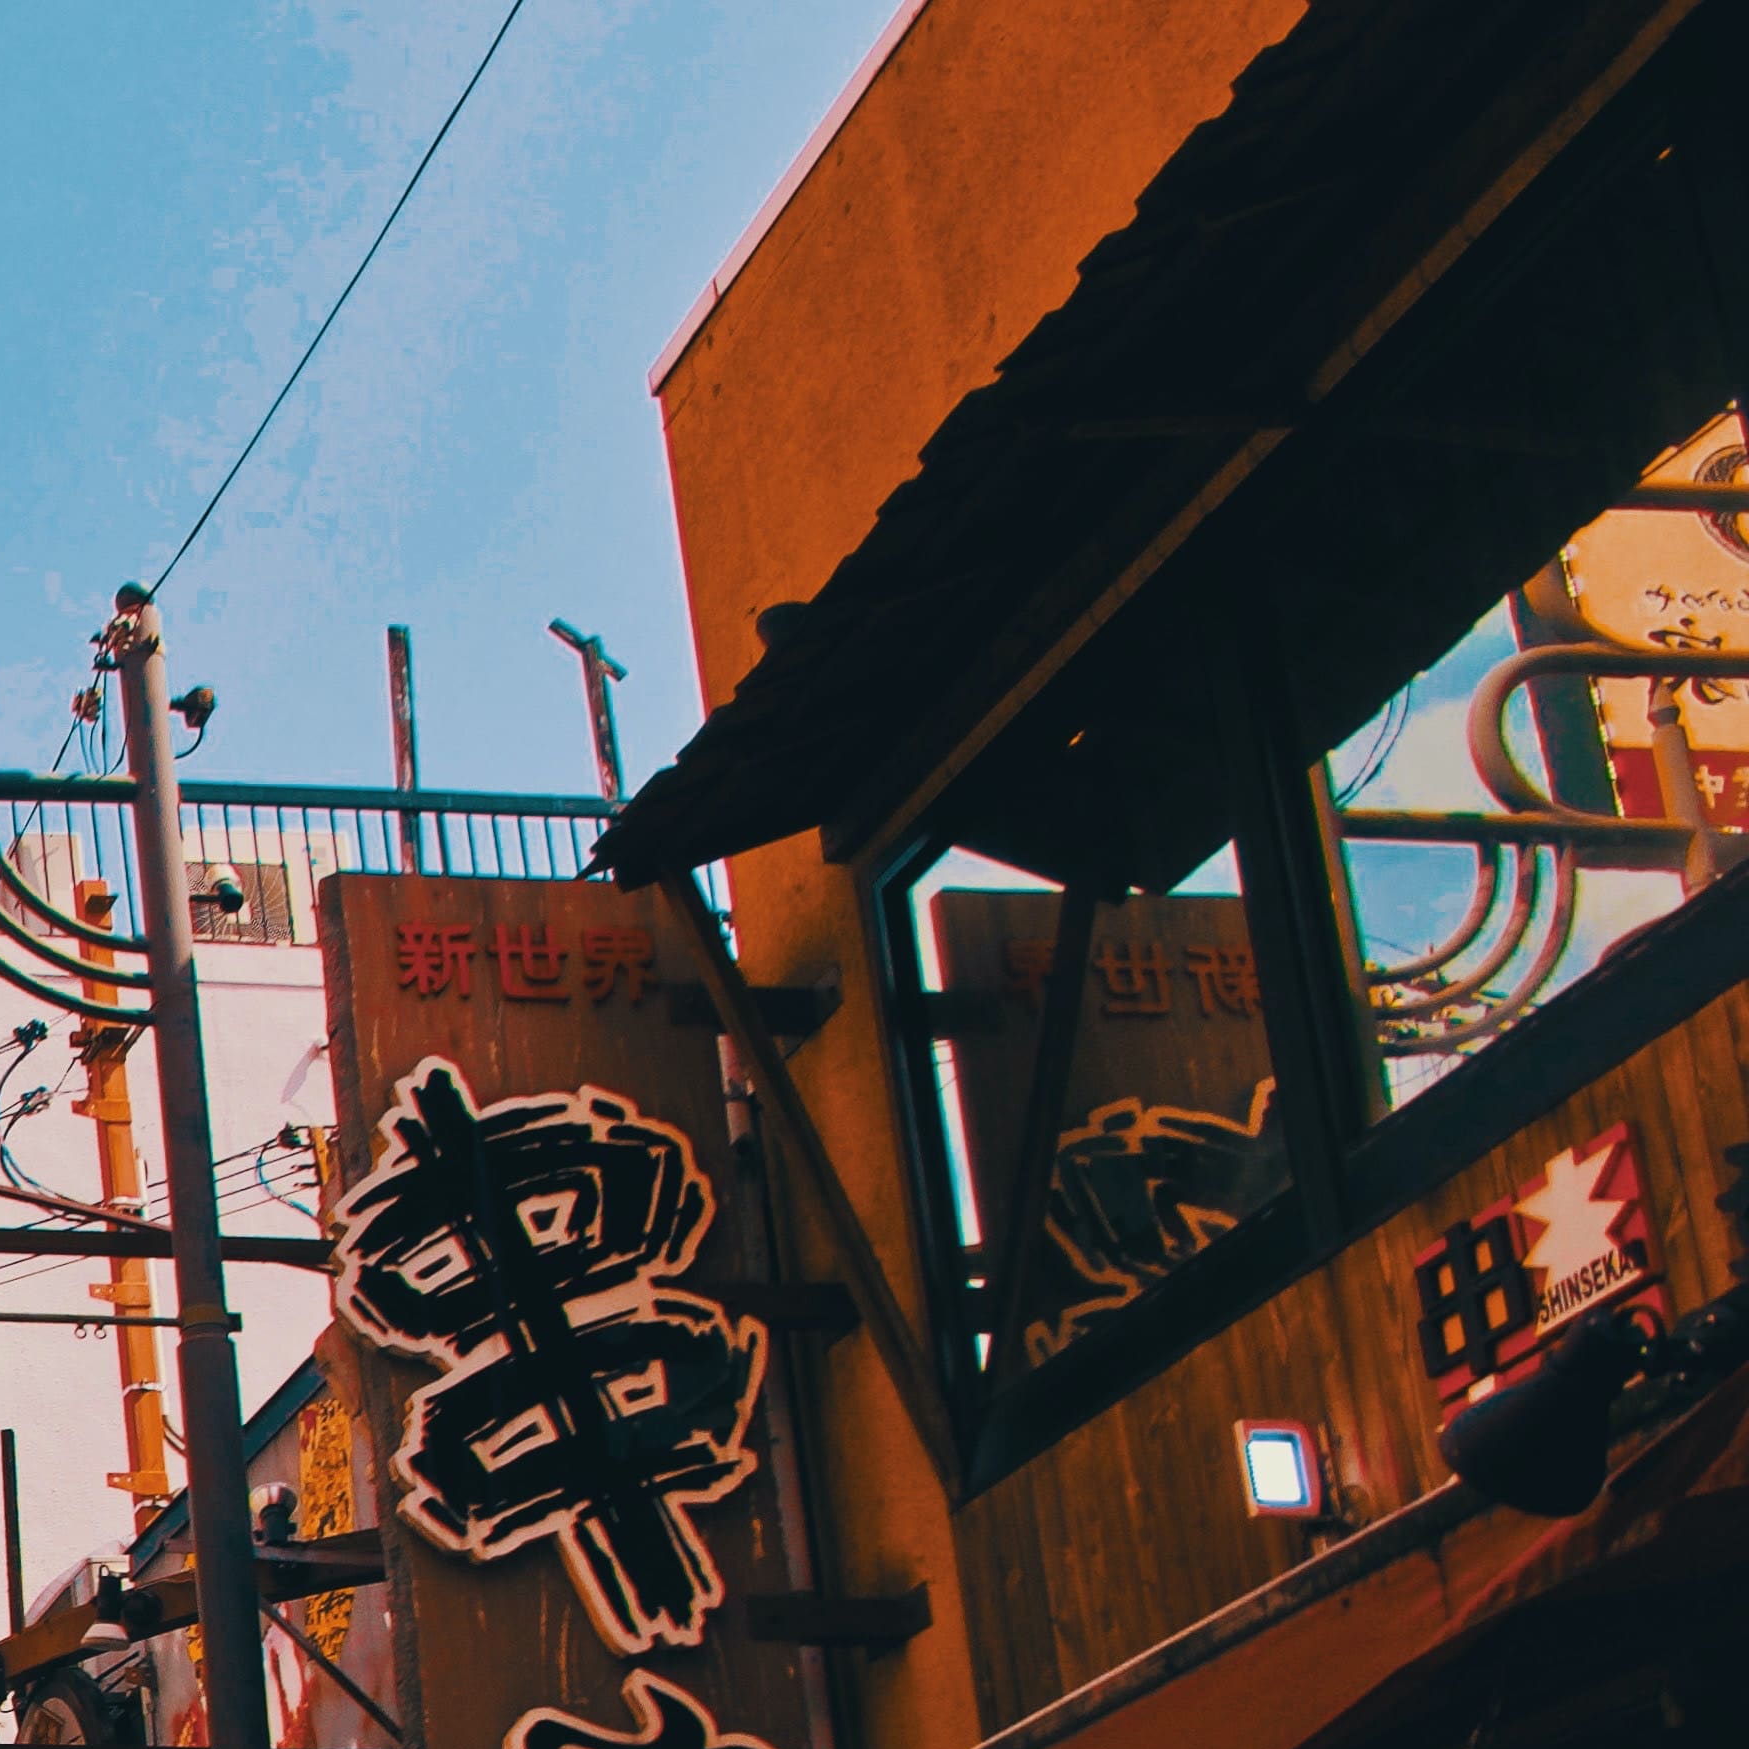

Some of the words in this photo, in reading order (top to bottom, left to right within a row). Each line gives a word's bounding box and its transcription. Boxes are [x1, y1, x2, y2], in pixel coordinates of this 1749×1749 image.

[397, 920, 660, 1001] 新世界
[1538, 1243, 1648, 1325] SHINSEKA
